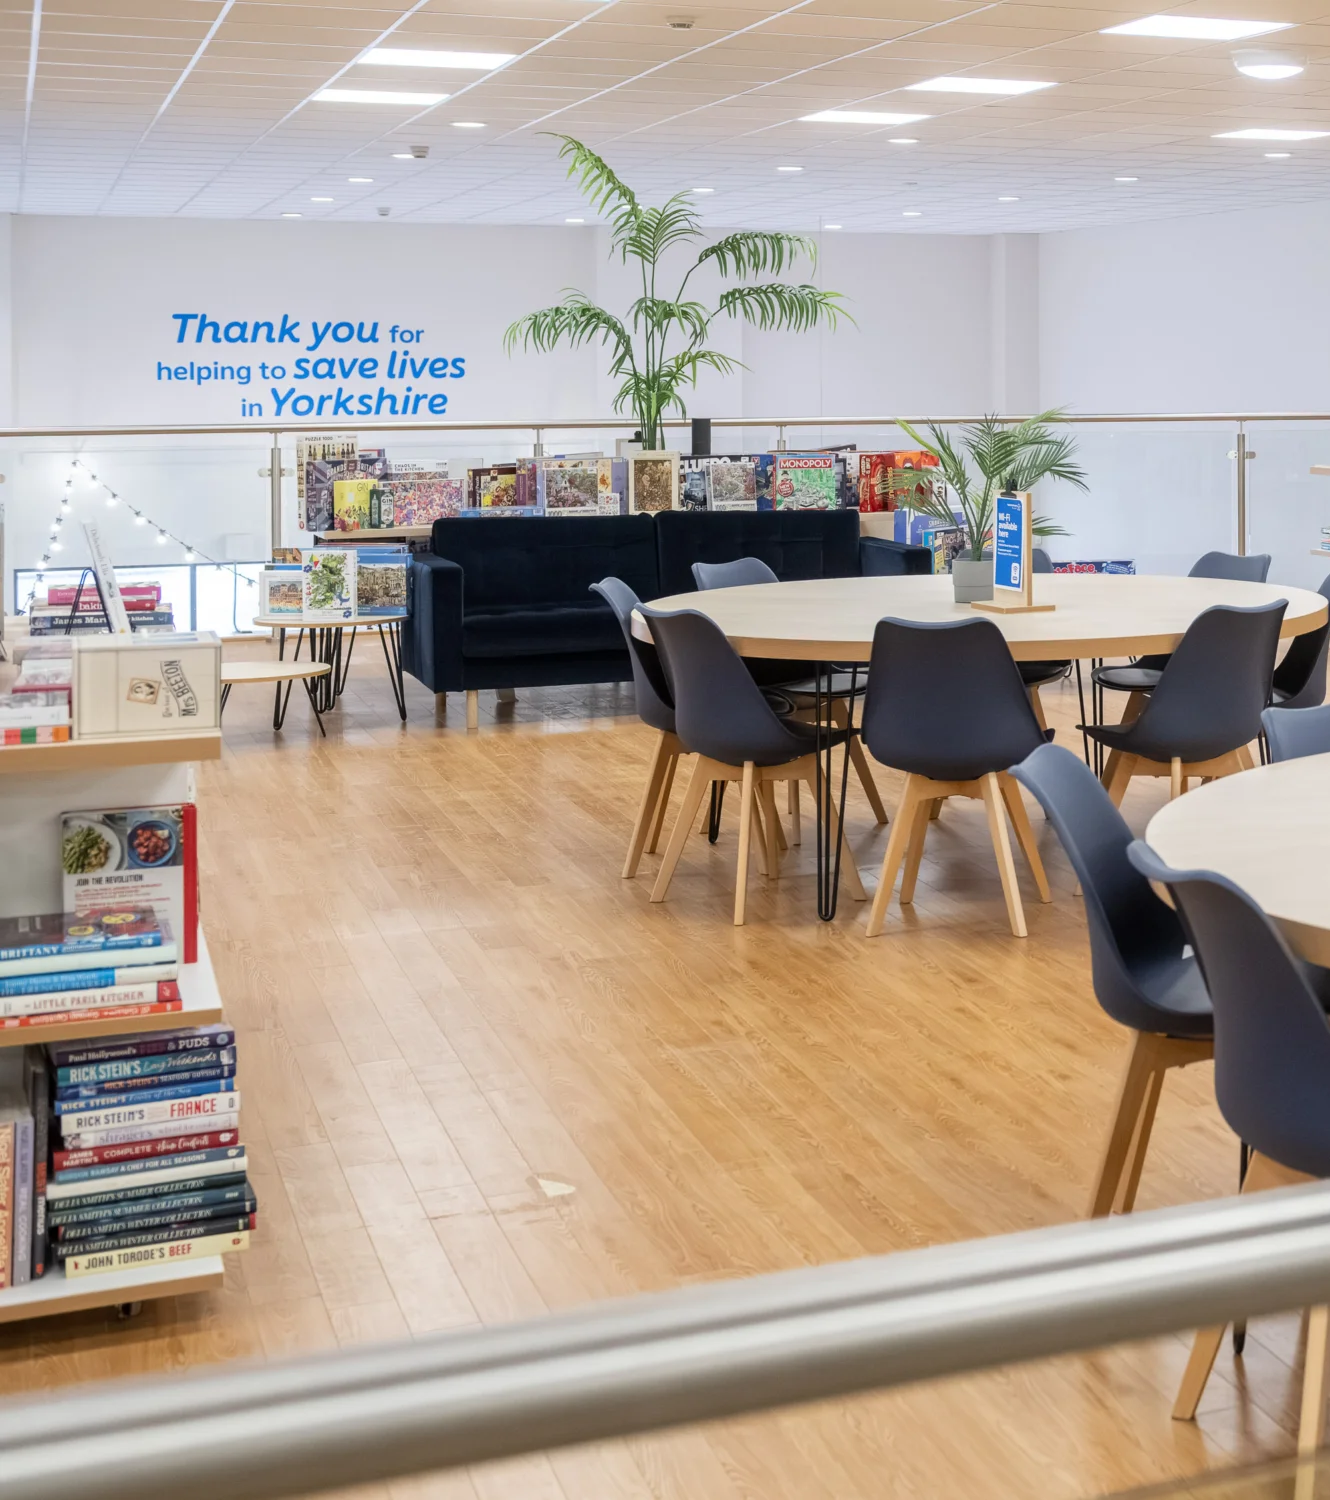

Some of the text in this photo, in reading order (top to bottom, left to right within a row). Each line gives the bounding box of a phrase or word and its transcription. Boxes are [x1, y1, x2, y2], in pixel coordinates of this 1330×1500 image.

[171, 313, 425, 352] Thank you for
[156, 350, 466, 385] helping to save lives
[241, 386, 449, 417] in Yorkshire
[780, 459, 831, 468] MONOPOLY
[356, 482, 369, 492] GIN
[131, 614, 154, 622] kitchen
[164, 660, 190, 699] BEETON
[76, 874, 143, 887] JOIN THE REVOLUTION
[0, 946, 59, 960] BRITTANY
[33, 990, 144, 1010] LITTLE PARIS KITCHEN
[68, 1054, 85, 1063] Paul
[178, 1036, 210, 1049] PUDS
[69, 1052, 217, 1083] RICK STEIN'S Weekends
[61, 1096, 126, 1111] RICK STEIN'S
[76, 1114, 101, 1129] RICK
[104, 1109, 145, 1125] STEIN'S
[169, 1098, 217, 1117] FRANCE
[0, 1126, 11, 1205] Nigel Slater
[63, 1155, 99, 1167] MARTIN'S
[68, 1149, 94, 1160] JAMES
[104, 1144, 152, 1159] COMPLETE
[120, 1153, 206, 1173] A CHEF FOR ALL SEASONS
[54, 1178, 206, 1210] DELIA COLLECTION
[36, 1196, 46, 1236] menus
[51, 1196, 205, 1226] DELIA COLLECTION
[65, 1208, 213, 1239] DELIA COLLECTION
[18, 1215, 28, 1262] COOKING
[57, 1226, 205, 1256] DELIA COLLECTION
[84, 1243, 192, 1270] JOHN TORODE'S BEEF
